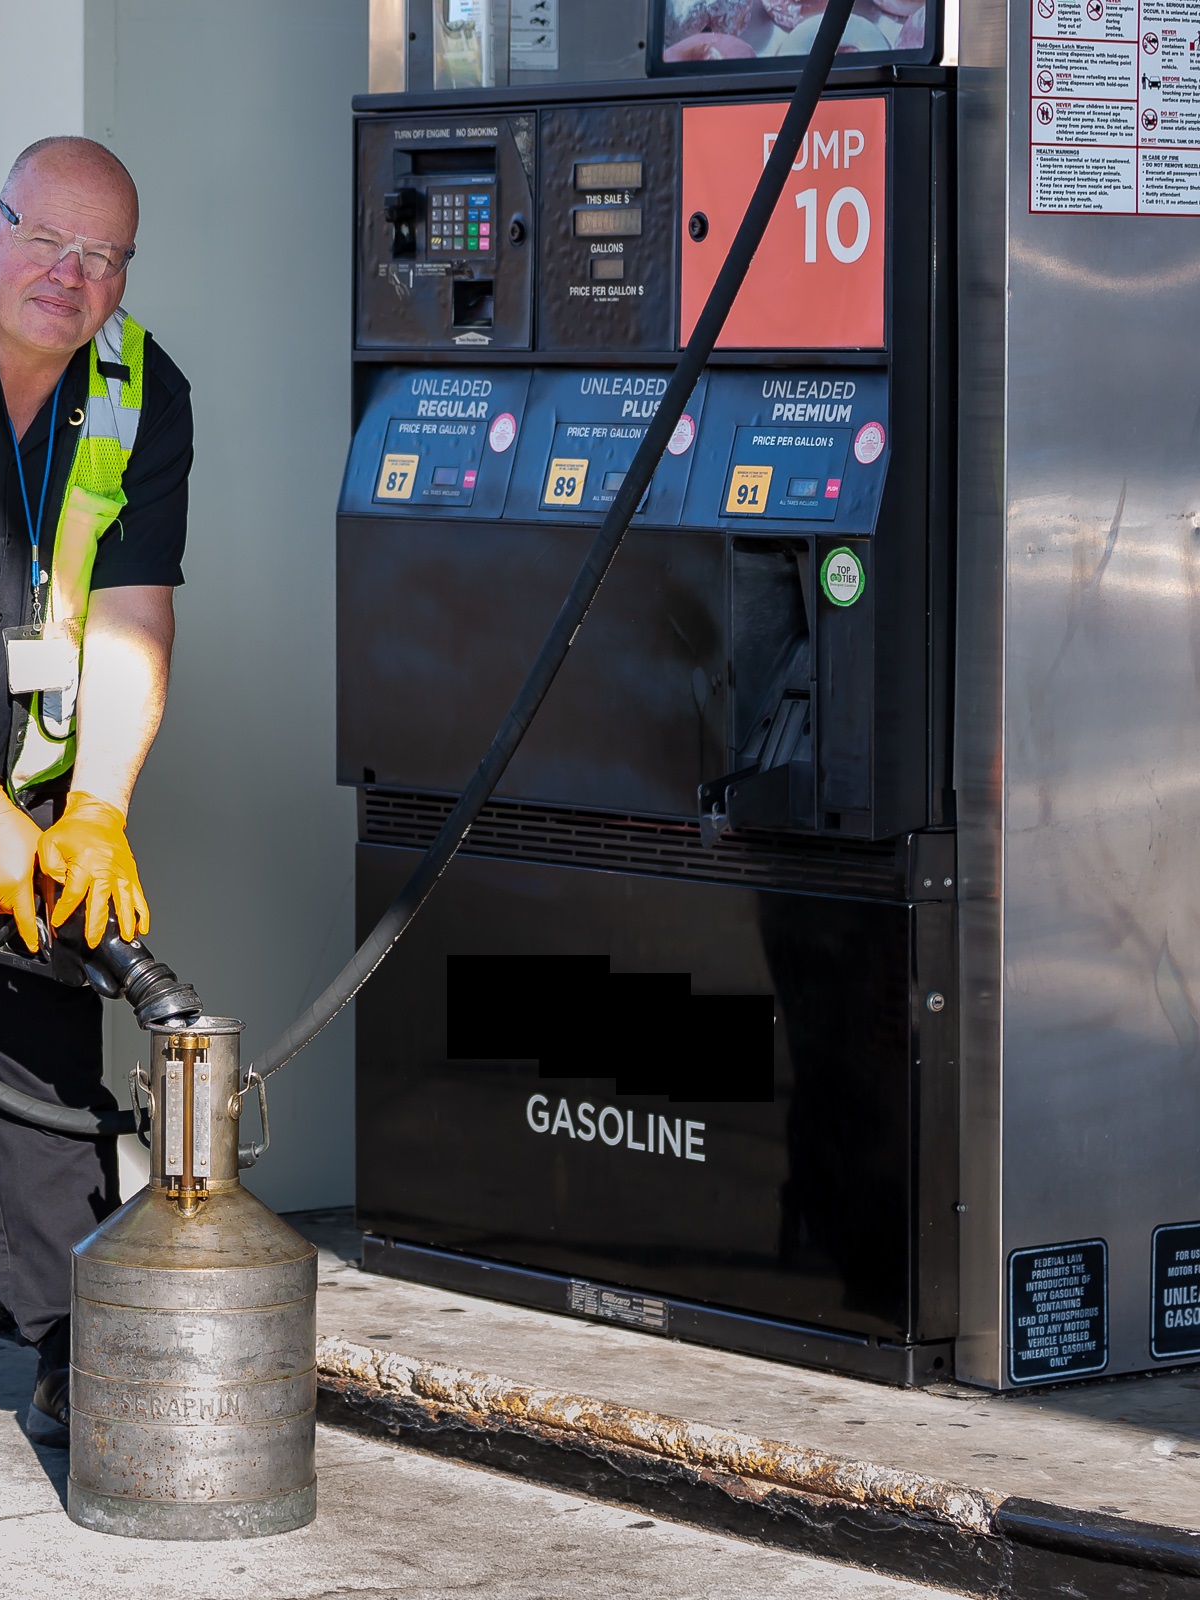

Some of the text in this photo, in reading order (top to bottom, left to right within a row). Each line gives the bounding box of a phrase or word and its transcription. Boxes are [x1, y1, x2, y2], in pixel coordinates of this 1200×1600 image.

[394, 127, 498, 139] TURN OFF ENGINE NO SMOKING
[586, 194, 629, 204] THIS SALE $
[795, 186, 870, 264] 10
[591, 243, 623, 253] GALLONS
[569, 286, 644, 296] PRICE PER GALLON $
[411, 379, 492, 396] UNLEADED
[580, 378, 667, 395] UNLEADED
[762, 381, 856, 399] UNLEADED
[418, 400, 488, 418] REGULAR
[772, 403, 852, 423] PREMIUM
[399, 424, 476, 435] PRICE PER GALLON $
[567, 427, 590, 437] PRICE
[592, 428, 607, 438] PER
[609, 428, 641, 438] GALLON
[752, 436, 834, 447] PRICE PER GALLON $
[386, 472, 408, 492] 87
[554, 476, 576, 497] 89
[736, 485, 759, 505] 91
[837, 566, 850, 574] TOP
[842, 575, 857, 583] TIER
[526, 1094, 705, 1162] GASOLINE
[1035, 1254, 1082, 1268] FEDERAL LAW
[1176, 1251, 1189, 1260] FOR
[1032, 1264, 1085, 1279] PROHIBITS THE
[1168, 1265, 1192, 1277] MOTOR
[1026, 1275, 1091, 1291] INTRODUCTION OF
[1032, 1287, 1084, 1302] ANY GASOLINE
[1164, 1285, 1200, 1306] UNLE
[1037, 1299, 1081, 1313] CONTAINING
[1019, 1307, 1098, 1326] LEAD OR PHOSPHORUS
[1028, 1320, 1090, 1336] INTO ANY MOTOR
[1028, 1331, 1089, 1347] VEHICLE LABELED
[1062, 1341, 1096, 1354] GASOLINE
[120, 1393, 241, 1418] SERAPHIN
